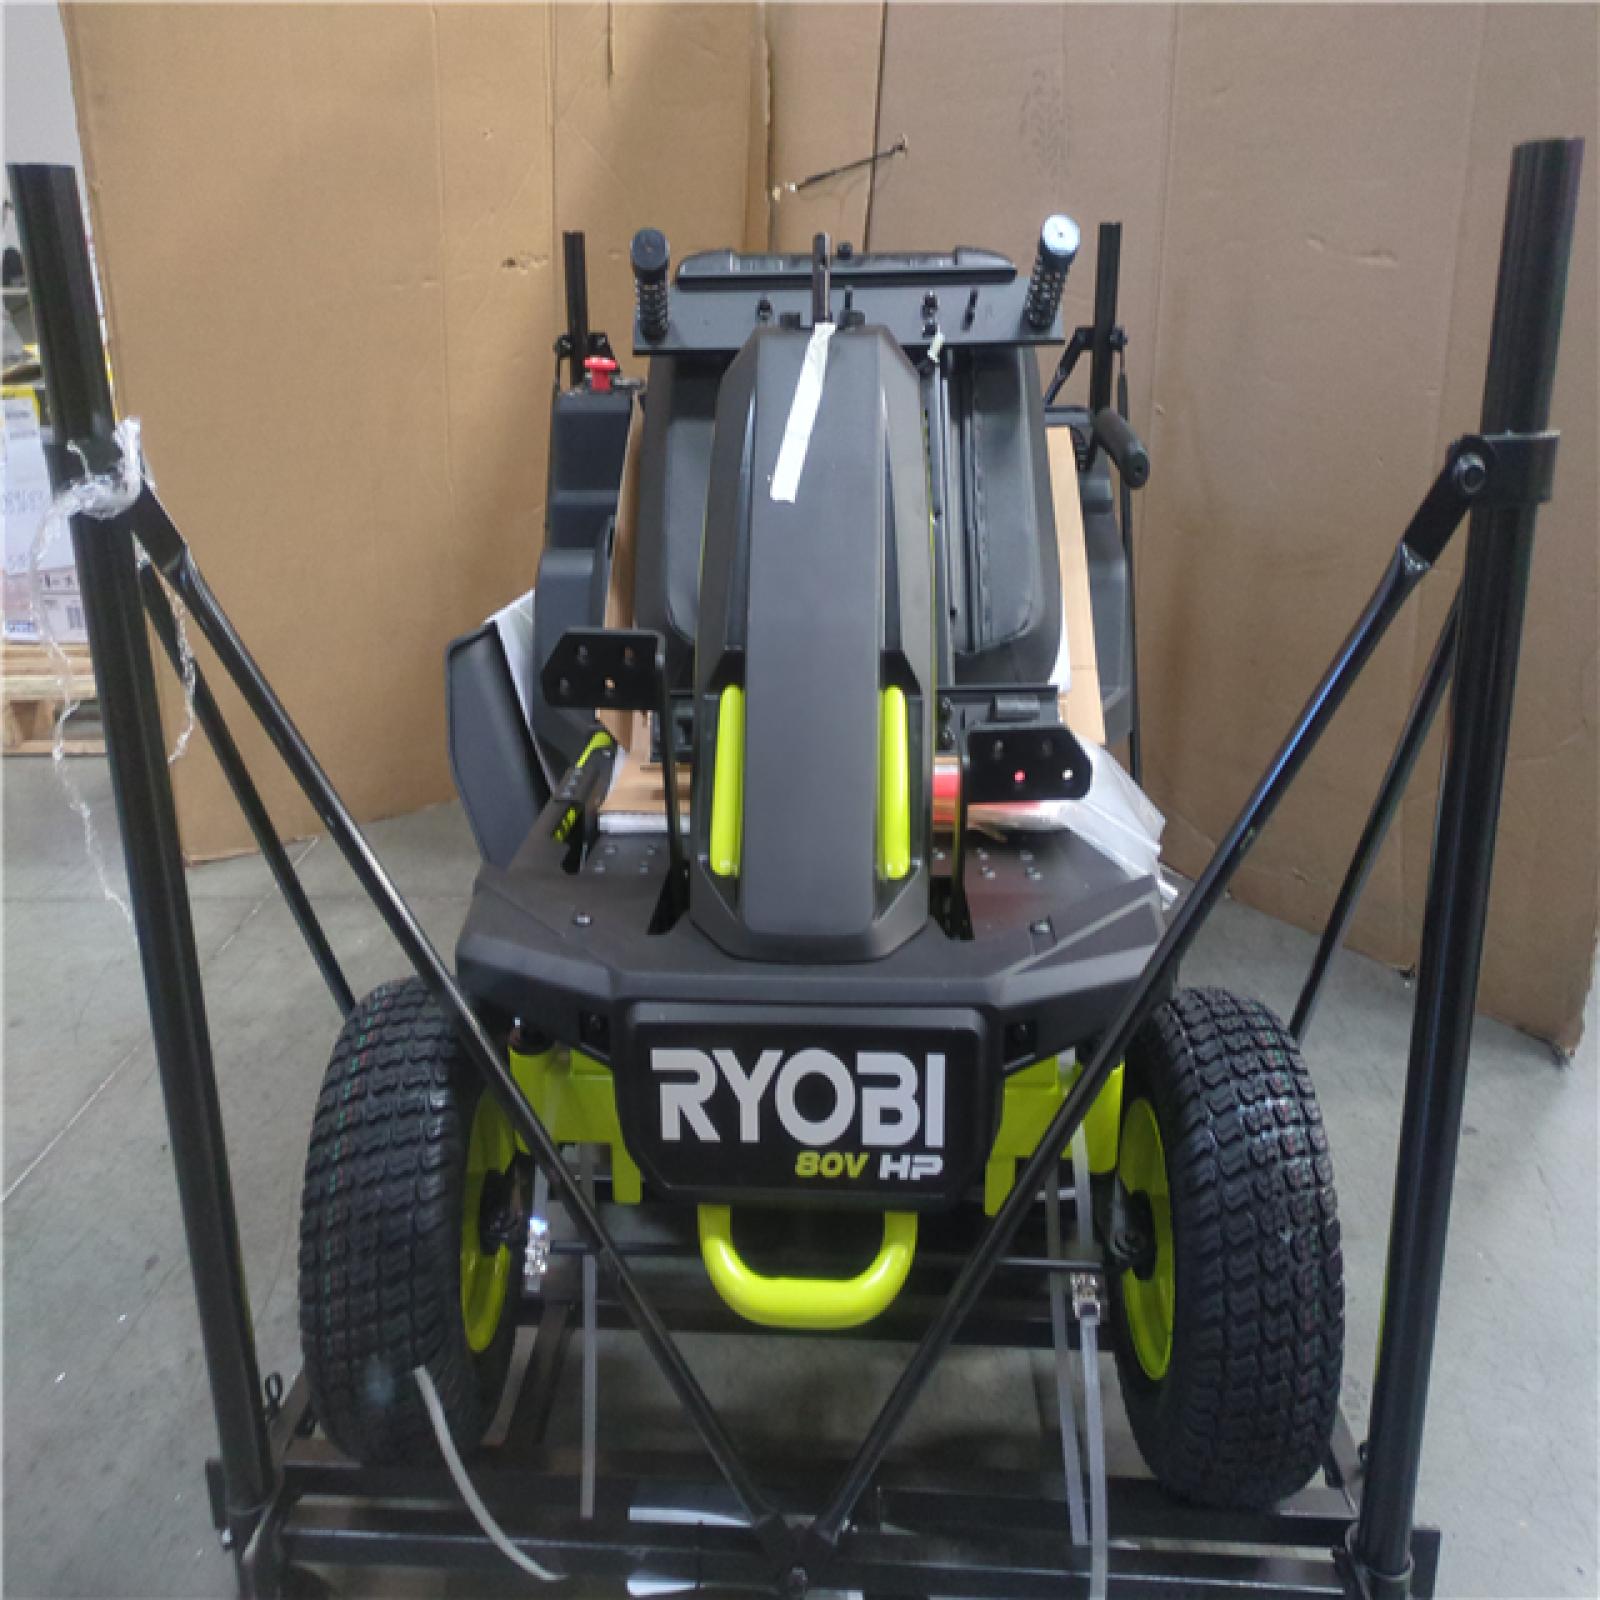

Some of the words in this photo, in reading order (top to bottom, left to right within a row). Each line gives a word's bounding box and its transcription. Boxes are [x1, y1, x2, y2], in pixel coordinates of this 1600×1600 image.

[651, 1047, 946, 1148] RYOBI
[794, 1151, 870, 1178] 80V
[878, 1153, 944, 1181] HP
